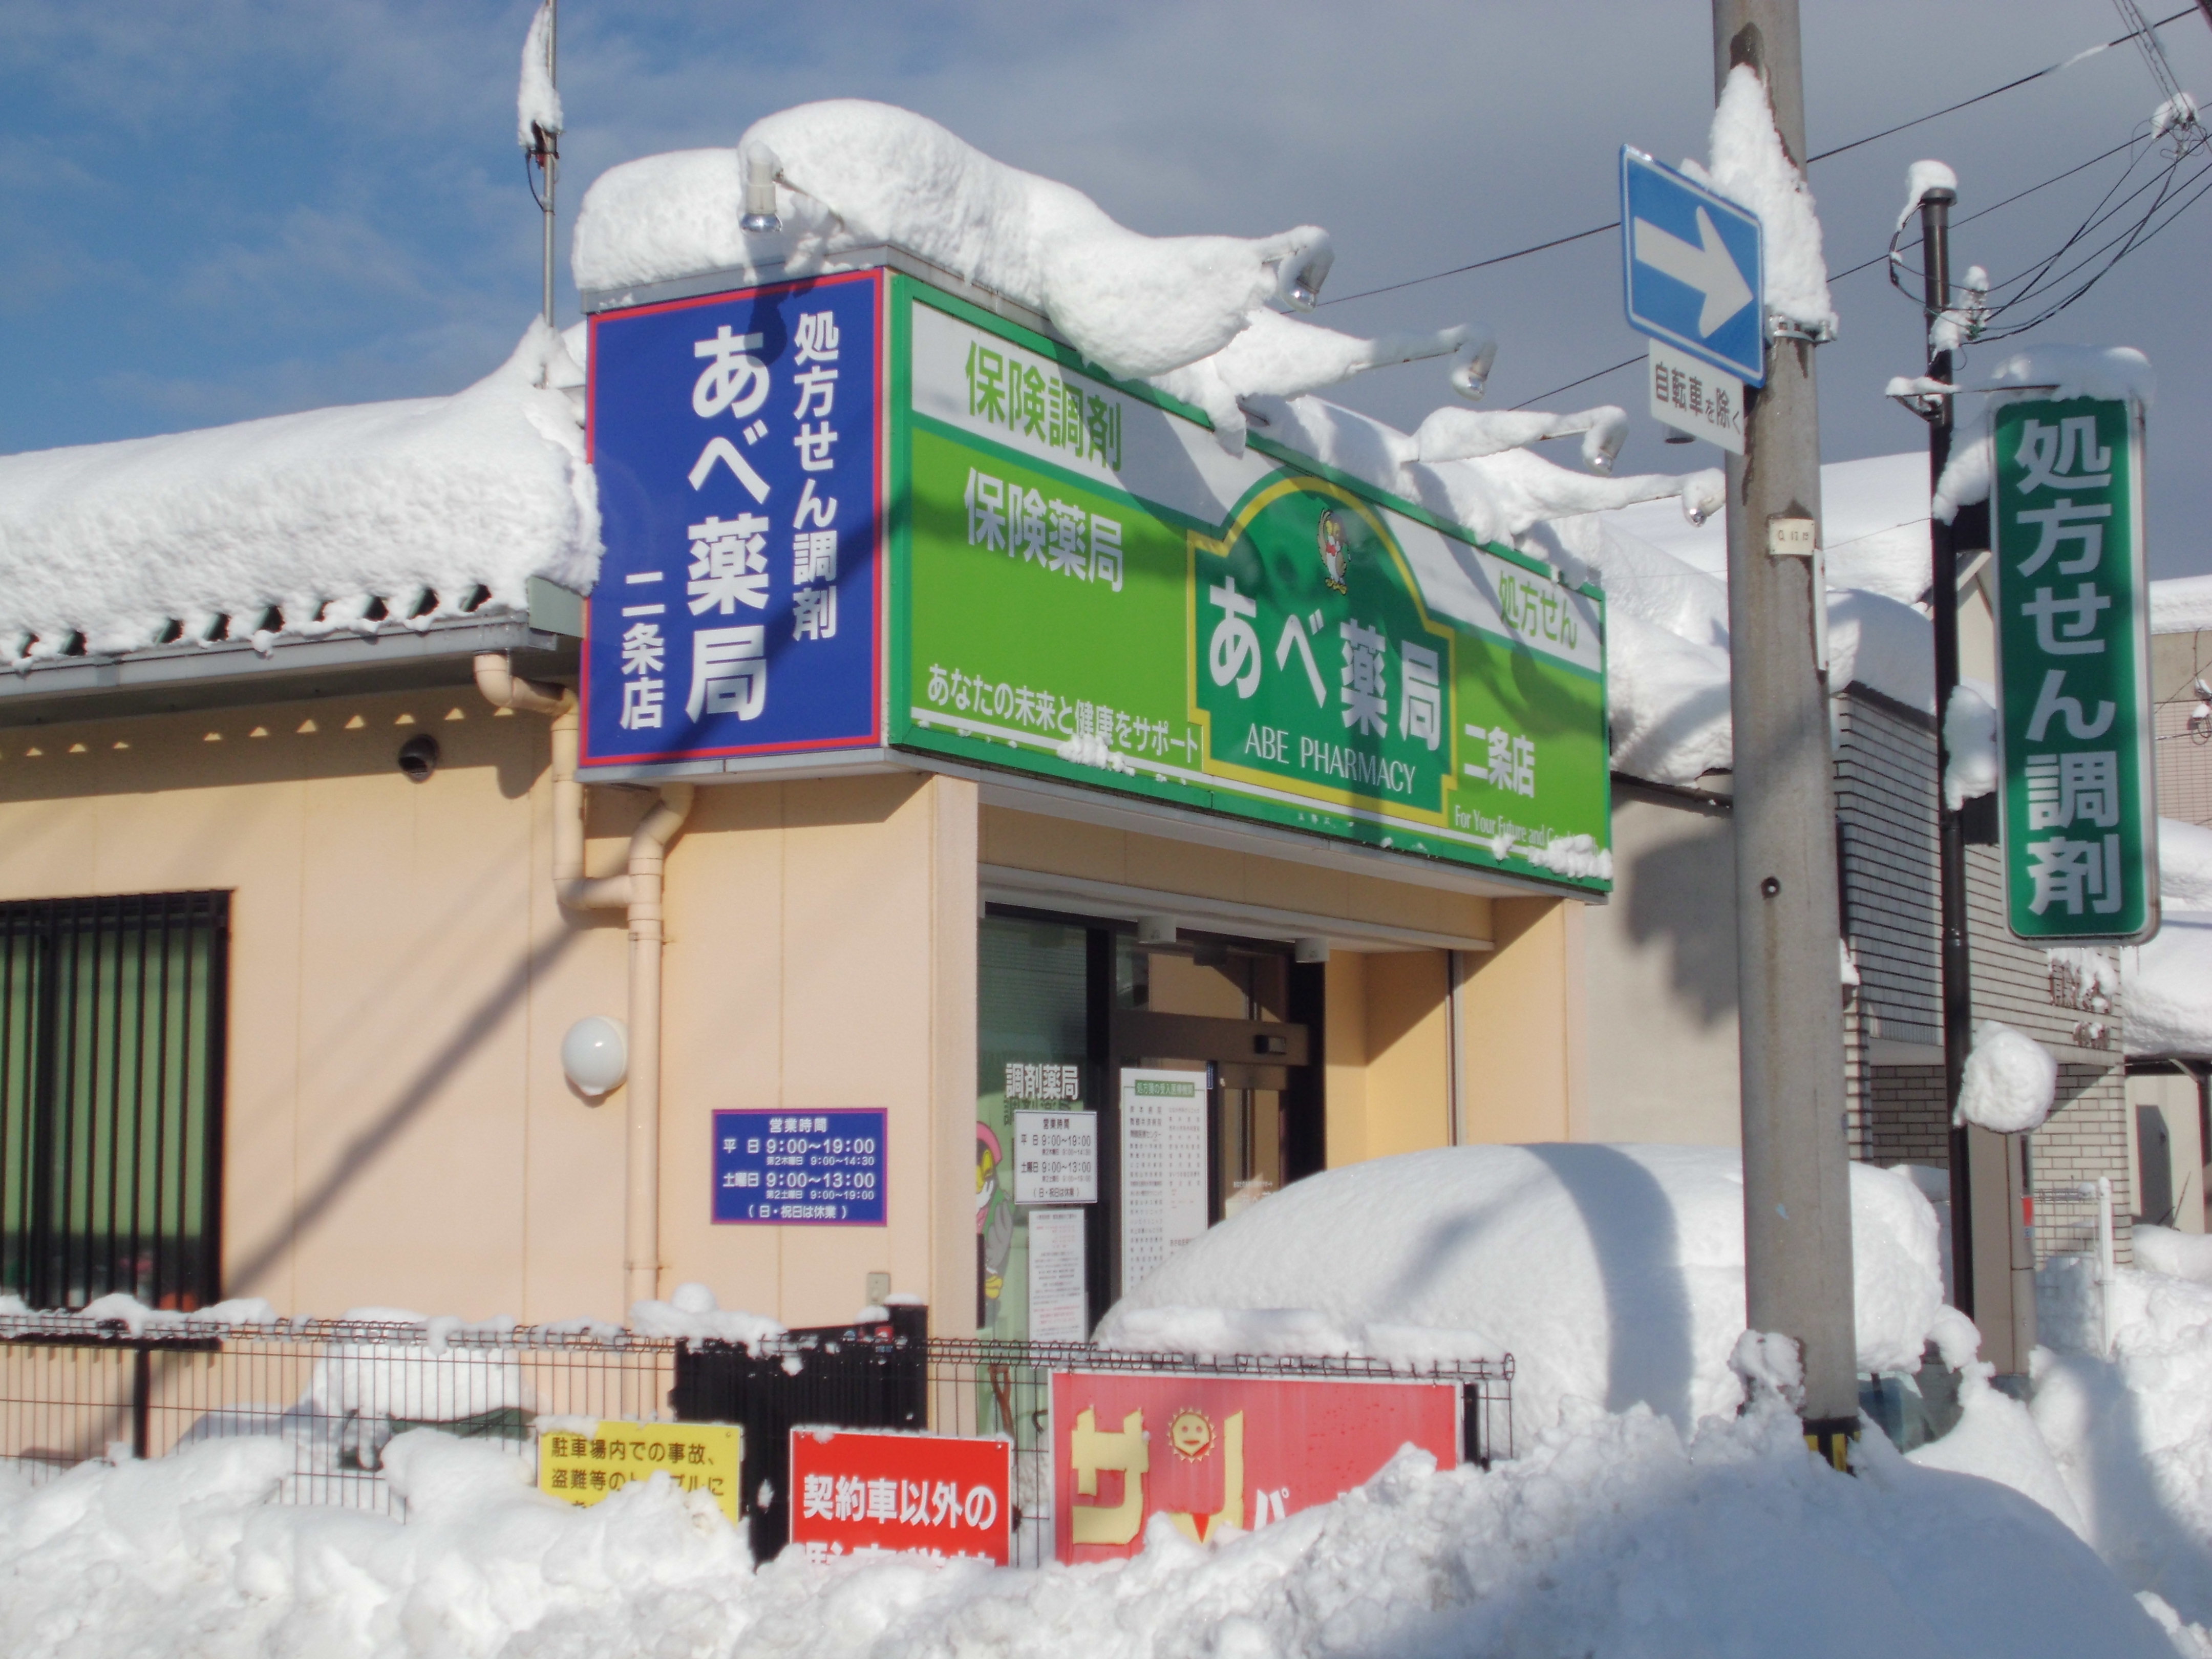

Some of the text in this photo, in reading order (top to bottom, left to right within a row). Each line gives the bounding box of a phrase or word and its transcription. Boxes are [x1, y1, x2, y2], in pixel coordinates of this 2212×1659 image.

[965, 339, 1122, 472] 保険調剤
[1655, 361, 1740, 435] 自転車を除く
[793, 310, 839, 642] 処方せん調剤
[685, 325, 771, 724] あべ薬局
[964, 466, 1124, 592] 保険薬局
[1498, 570, 1578, 650] 処方せん
[620, 571, 665, 730] 二条店
[1209, 576, 1441, 751] あべ薬局
[2014, 415, 2122, 916] 処方せん調剤
[927, 663, 1198, 763] あなたの未来と健康をサポート
[1245, 723, 1416, 795] ABE PHARMACY
[1463, 723, 1535, 798] 二条店
[1455, 804, 1471, 828] For
[1473, 809, 1496, 835] Your
[1528, 824, 1545, 846] and
[1005, 1063, 1079, 1100] 調剤薬局
[766, 1138, 875, 1154] 9:00～19:00
[770, 1118, 827, 1133] 営業時間
[1043, 1118, 1070, 1130] 営業時間
[722, 1172, 875, 1188] 土曜日 9:00～13:00
[766, 1156, 803, 1166] 第2木曜日
[1021, 1162, 1038, 1173] 土曜日
[766, 1190, 803, 1200] 第2土曜日
[550, 1468, 725, 1496] 盗難等のブルに
[551, 1437, 714, 1465] 駐車場内での事故、
[802, 1473, 998, 1531] 契約車以外の
